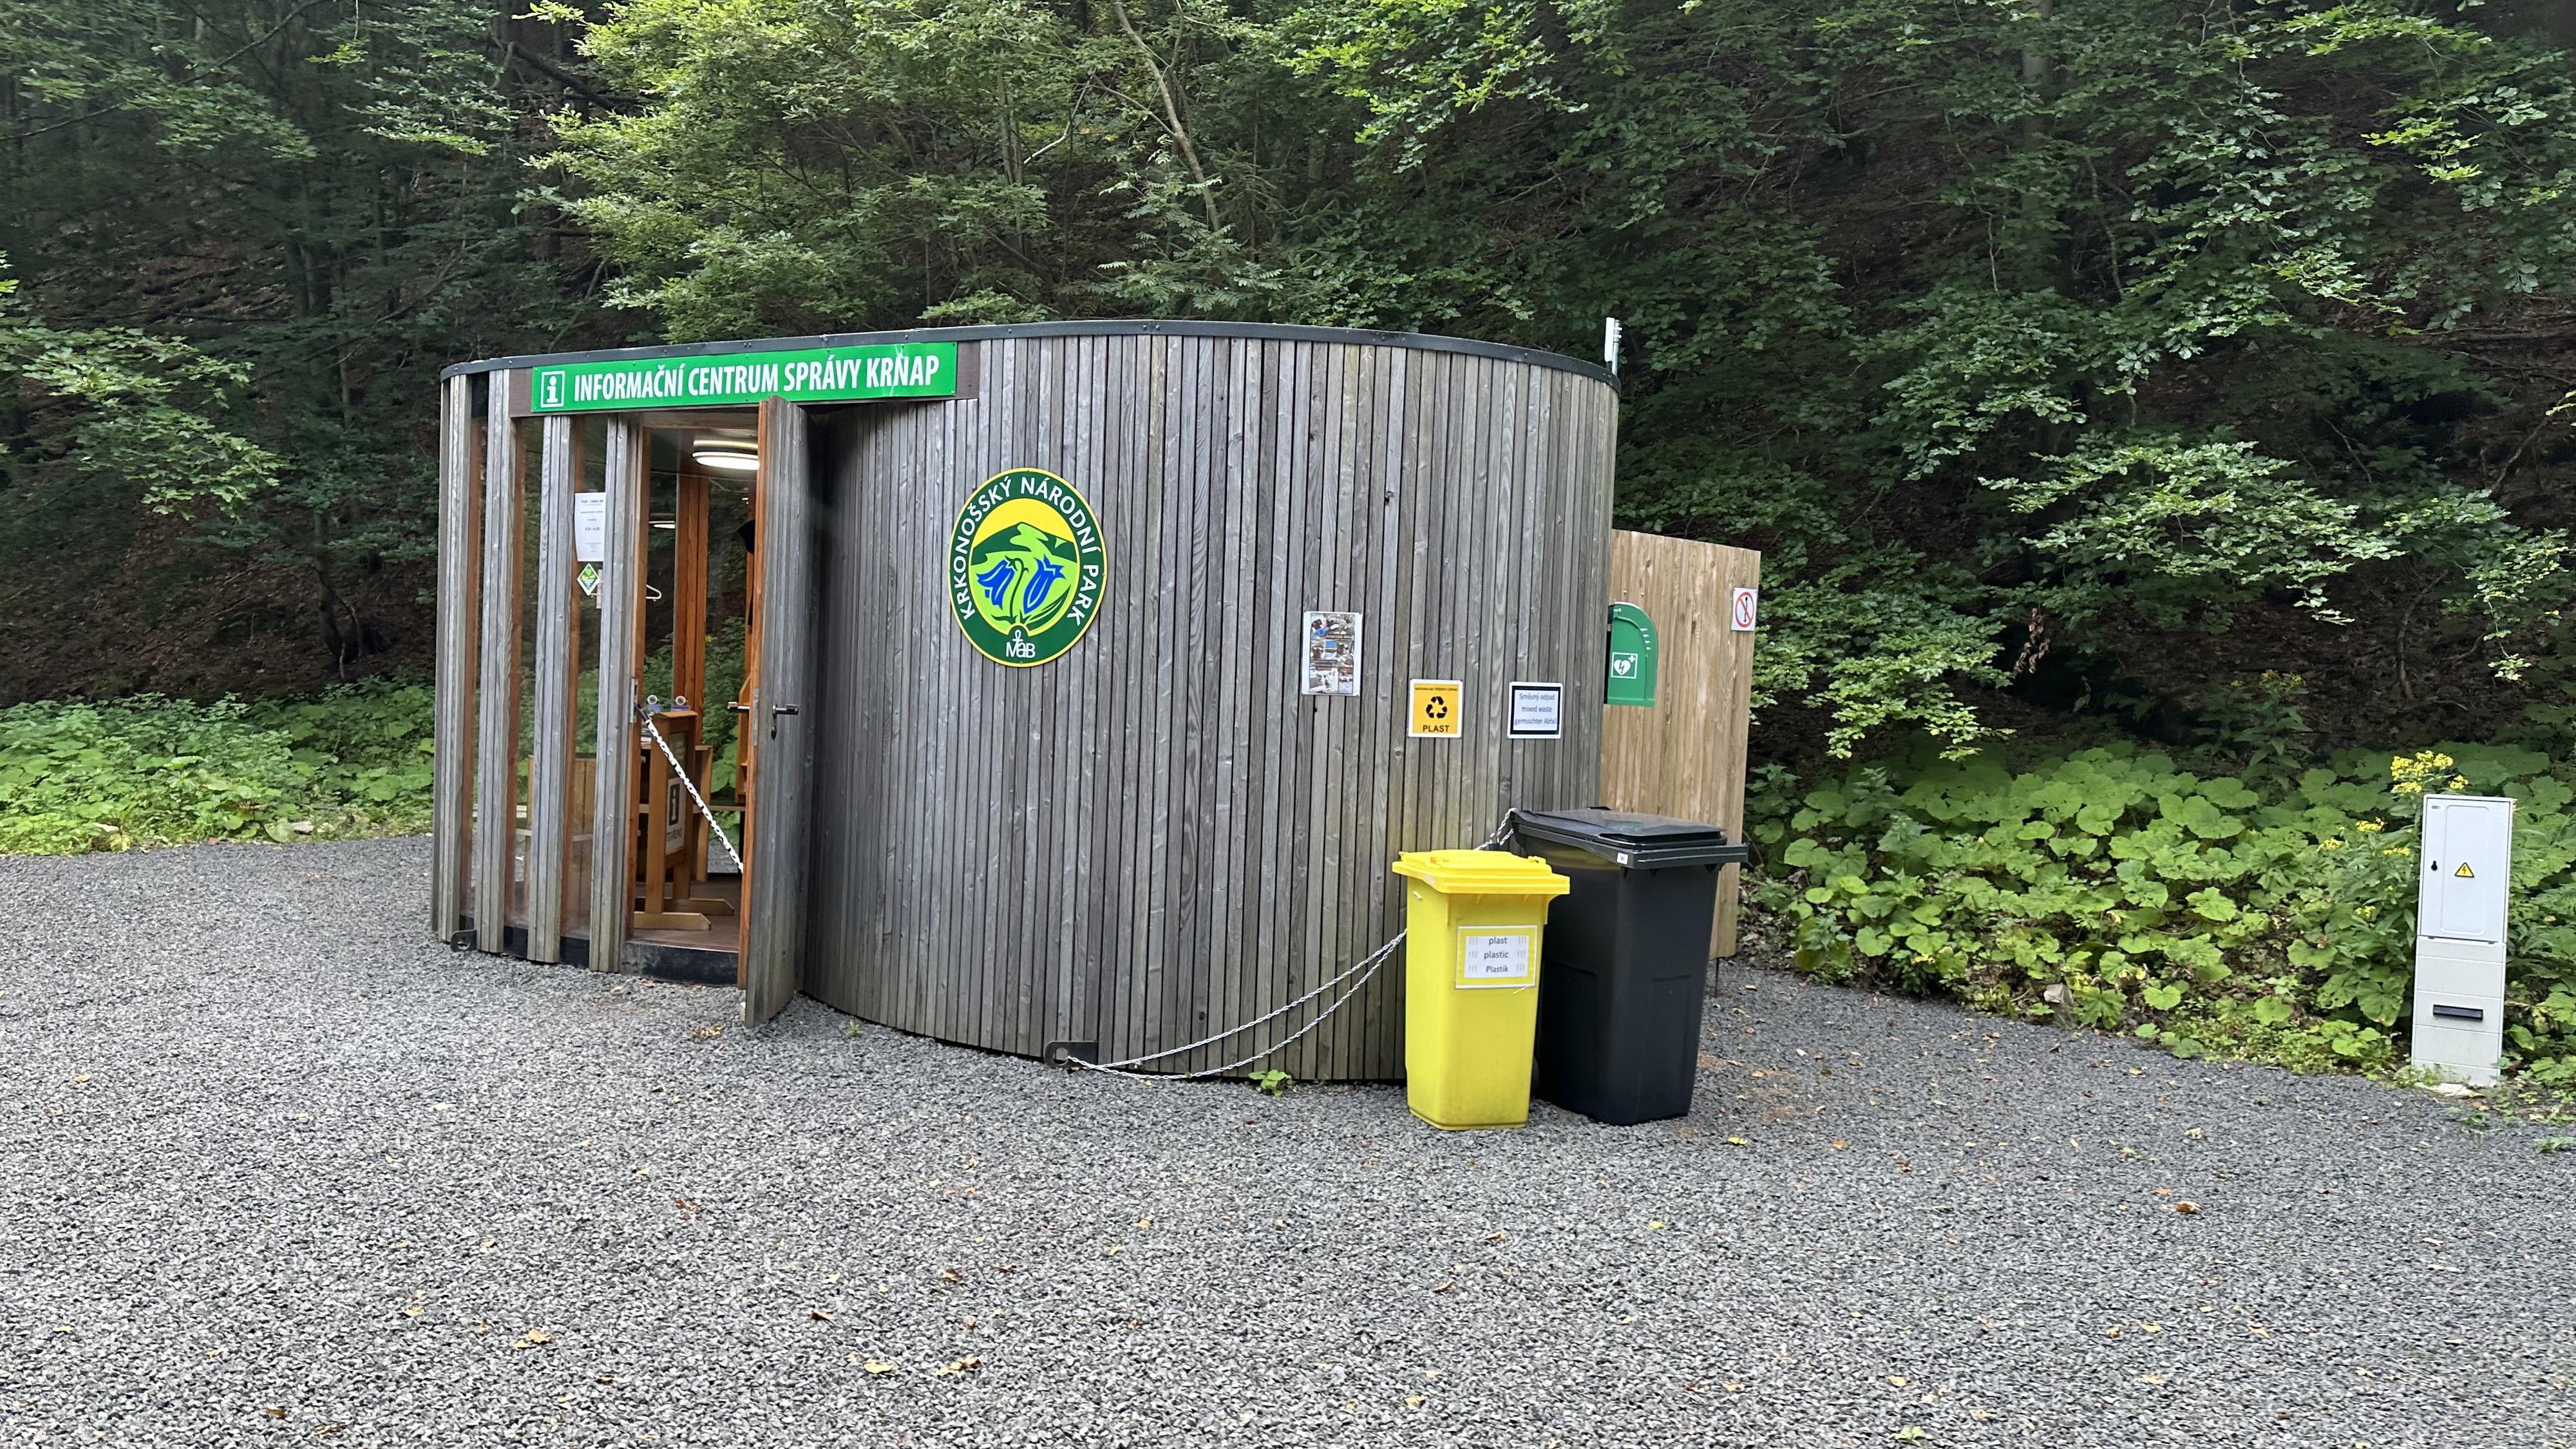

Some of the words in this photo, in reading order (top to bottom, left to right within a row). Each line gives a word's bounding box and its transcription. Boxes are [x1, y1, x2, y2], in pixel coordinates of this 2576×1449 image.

[574, 363, 686, 402] INFORMAČNÍ
[688, 364, 778, 396] CENTRUM
[784, 355, 862, 392] SPRÁVY
[953, 475, 1012, 620] KRKONOŠSKÝ
[1021, 477, 1101, 554] NÁRODNÍ
[1066, 564, 1099, 627] PARK
[1422, 724, 1450, 733] PLAST
[1488, 936, 1508, 945] plast
[1484, 951, 1509, 960] plastic
